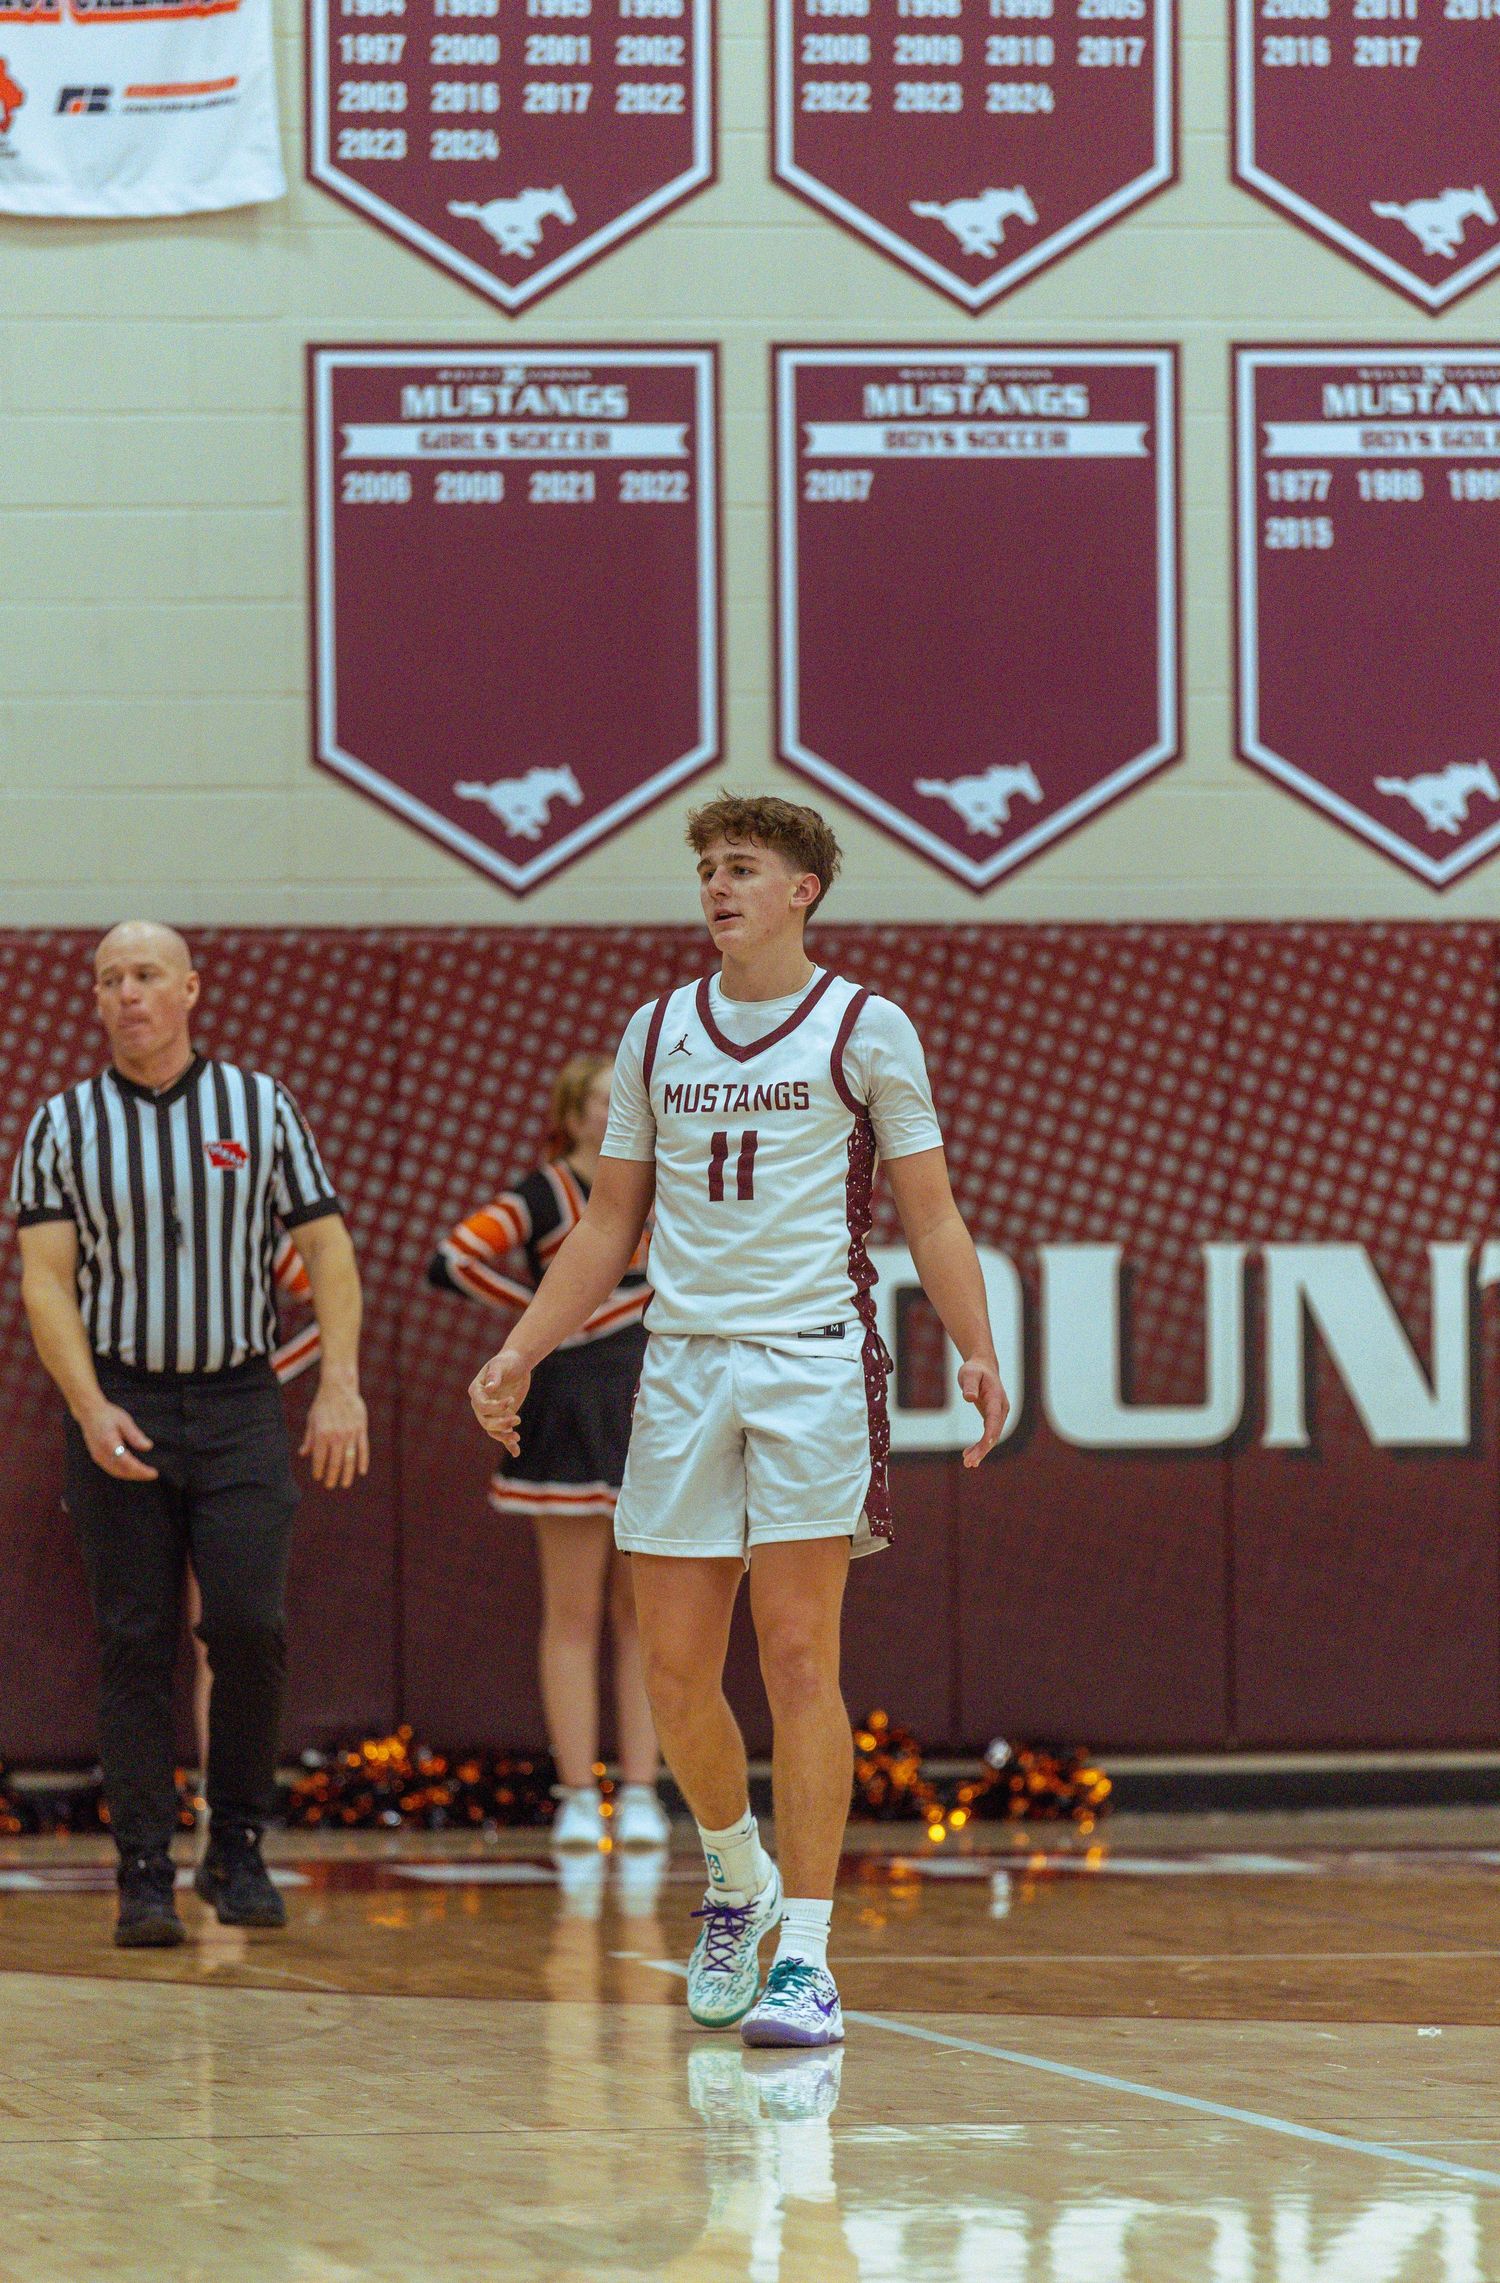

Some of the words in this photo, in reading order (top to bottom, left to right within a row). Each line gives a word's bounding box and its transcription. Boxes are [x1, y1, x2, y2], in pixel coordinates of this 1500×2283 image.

[338, 33, 407, 65] 1997
[430, 34, 501, 65] 2000
[524, 34, 592, 66] 2001
[615, 35, 686, 66] 2002
[985, 35, 1055, 66] 2010
[1077, 36, 1146, 67] 2017
[1261, 35, 1332, 67] 2016
[1353, 36, 1423, 67] 2017
[338, 81, 408, 113] 2003
[430, 81, 501, 113] 2016
[523, 82, 593, 114] 2017
[615, 83, 686, 114] 2022
[801, 81, 872, 113] 2022
[893, 82, 964, 113] 2023
[985, 82, 1056, 113] 2024
[338, 128, 408, 160] 2023
[430, 129, 501, 161] 2024
[402, 383, 630, 419] MUSTANGS
[863, 383, 1091, 418] MUSTANGS
[1322, 382, 1500, 418] MUSTAN
[507, 431, 611, 451] SOCCER
[884, 430, 957, 449] BOYS
[966, 430, 1070, 449] SOCCER
[528, 470, 596, 503] 2021
[619, 470, 690, 503] 2022
[804, 469, 875, 502] 2007
[1265, 468, 1333, 502] 1977
[1265, 516, 1335, 550] 2015
[663, 1081, 810, 1115] MUSTANGS
[707, 1130, 758, 1202] 11
[830, 1323, 839, 1332] M
[866, 1243, 1500, 1452] OUN
